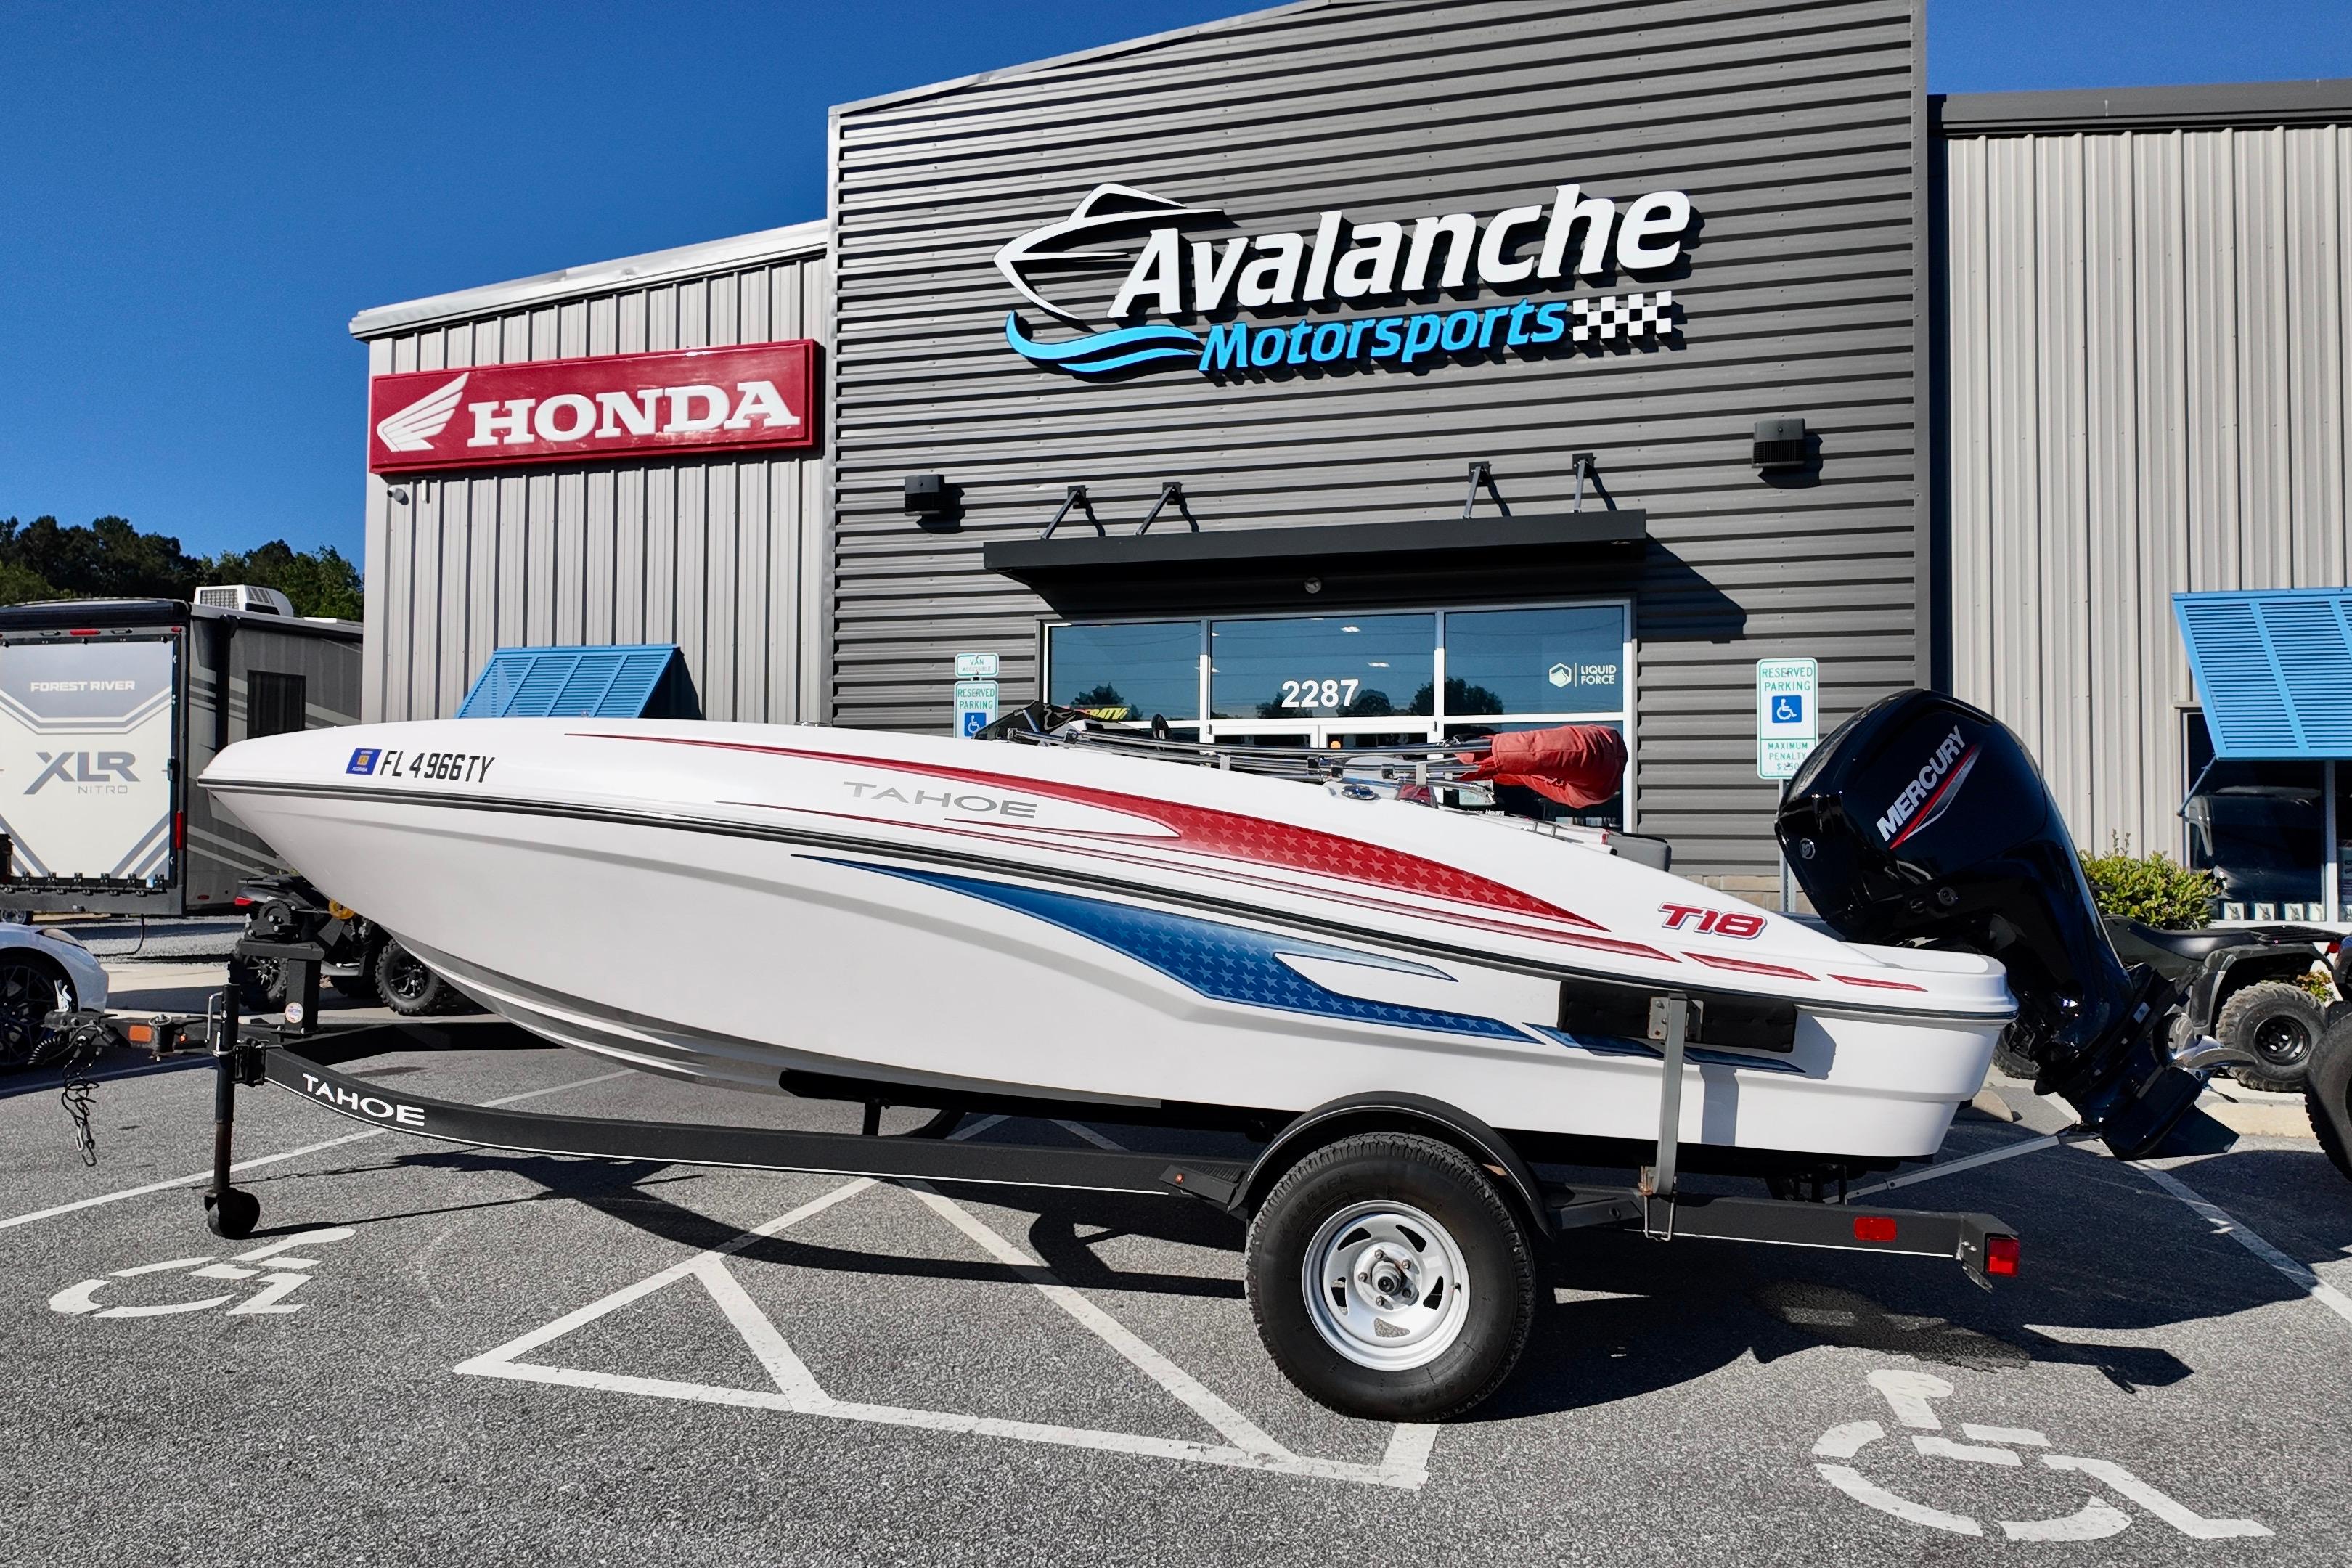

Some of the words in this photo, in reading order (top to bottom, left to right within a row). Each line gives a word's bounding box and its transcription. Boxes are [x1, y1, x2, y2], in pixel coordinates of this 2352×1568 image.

[1107, 183, 1691, 318] Avalanche
[1198, 297, 1568, 372] Motorsports
[467, 380, 801, 448] HONDA
[1580, 665, 1617, 674] LIQUID
[1761, 666, 1813, 678] RESERVED
[30, 681, 87, 692] FOREST
[90, 680, 136, 690] RIVER
[1580, 675, 1615, 685] FORCE
[1764, 680, 1811, 691] PARKING
[957, 688, 995, 698] RESERVED
[1281, 679, 1359, 707] 2287
[959, 700, 994, 709] PARKING
[379, 750, 404, 776] FL
[1768, 752, 1807, 761] PENALTY
[23, 751, 141, 795] XLR
[1776, 762, 1800, 771] $250
[78, 785, 128, 794] NITRO
[1876, 724, 1966, 841] MERCURY
[843, 781, 1037, 819] TAHOE
[1659, 902, 1766, 939] T18
[302, 1073, 425, 1127] TAHOE
